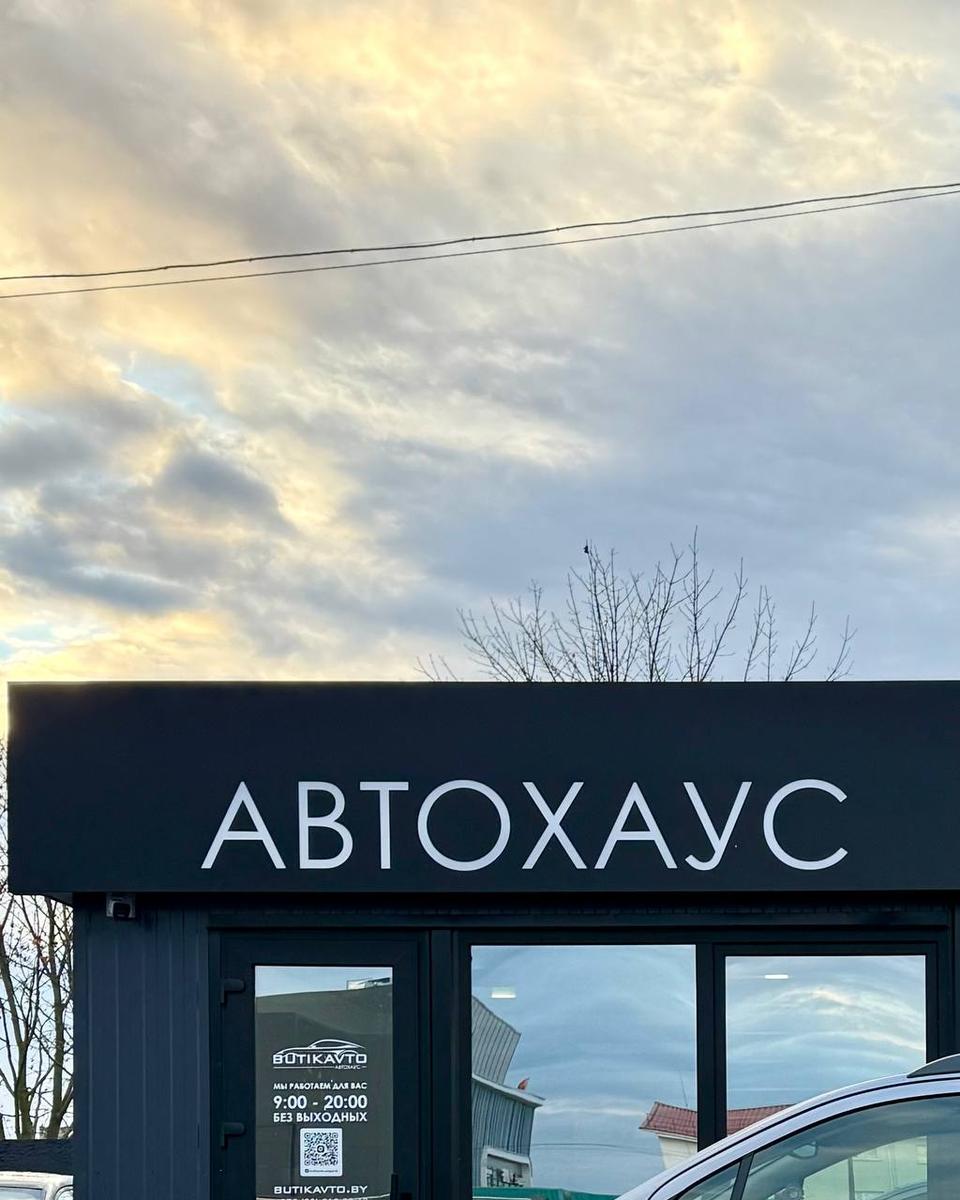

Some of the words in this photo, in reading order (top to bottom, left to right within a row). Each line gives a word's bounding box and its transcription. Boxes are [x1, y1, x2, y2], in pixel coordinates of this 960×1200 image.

[201, 778, 850, 872] АВТОХАУС
[272, 1053, 367, 1064] BUTIKAVTO
[332, 1082, 349, 1090] ДЛЯ
[350, 1082, 367, 1090] ВАС
[273, 1095, 307, 1109] 9:00
[324, 1095, 368, 1109] 20:00
[273, 1112, 293, 1122] БЕЗ
[296, 1112, 368, 1123] ВЫХОДНЫХ
[273, 1185, 368, 1194] BUTIKAVTO.BY
